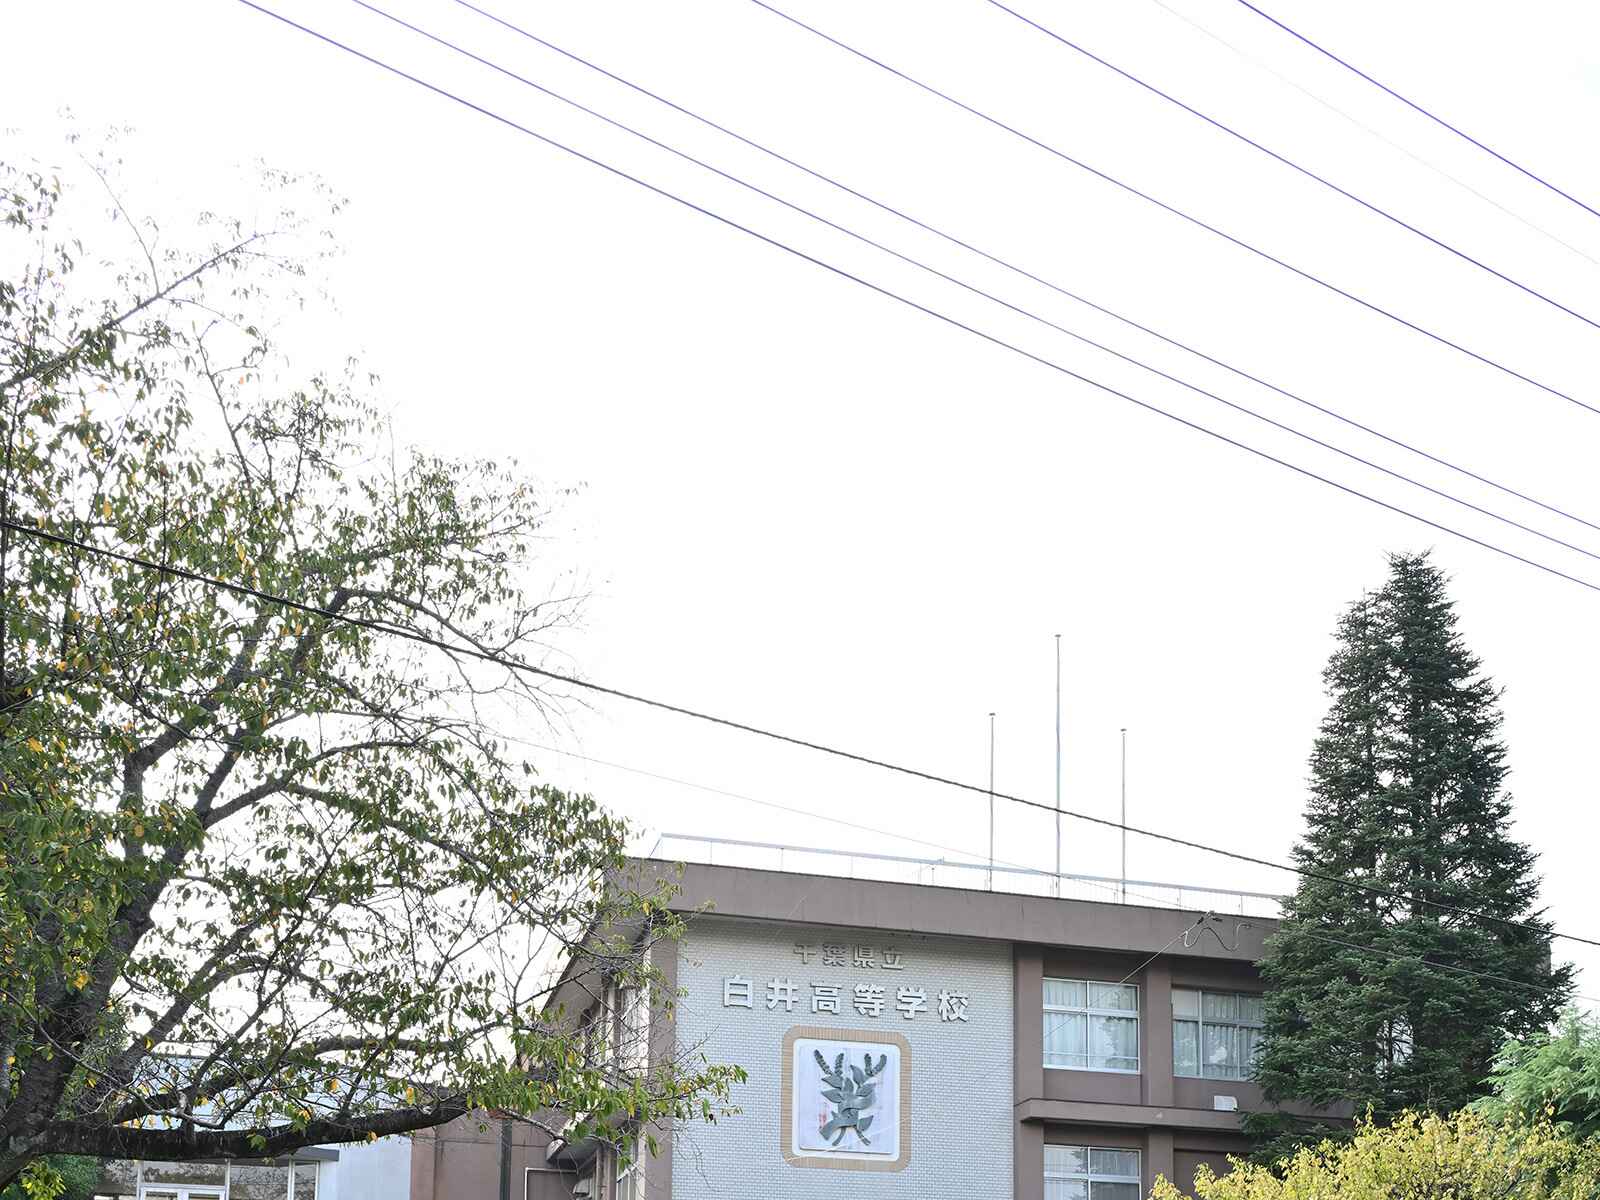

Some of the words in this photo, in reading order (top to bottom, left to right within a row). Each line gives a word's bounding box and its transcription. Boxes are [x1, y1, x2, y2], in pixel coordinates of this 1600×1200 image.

[793, 943, 904, 970] 千葉県立
[723, 975, 969, 1021] 白井高等学校
